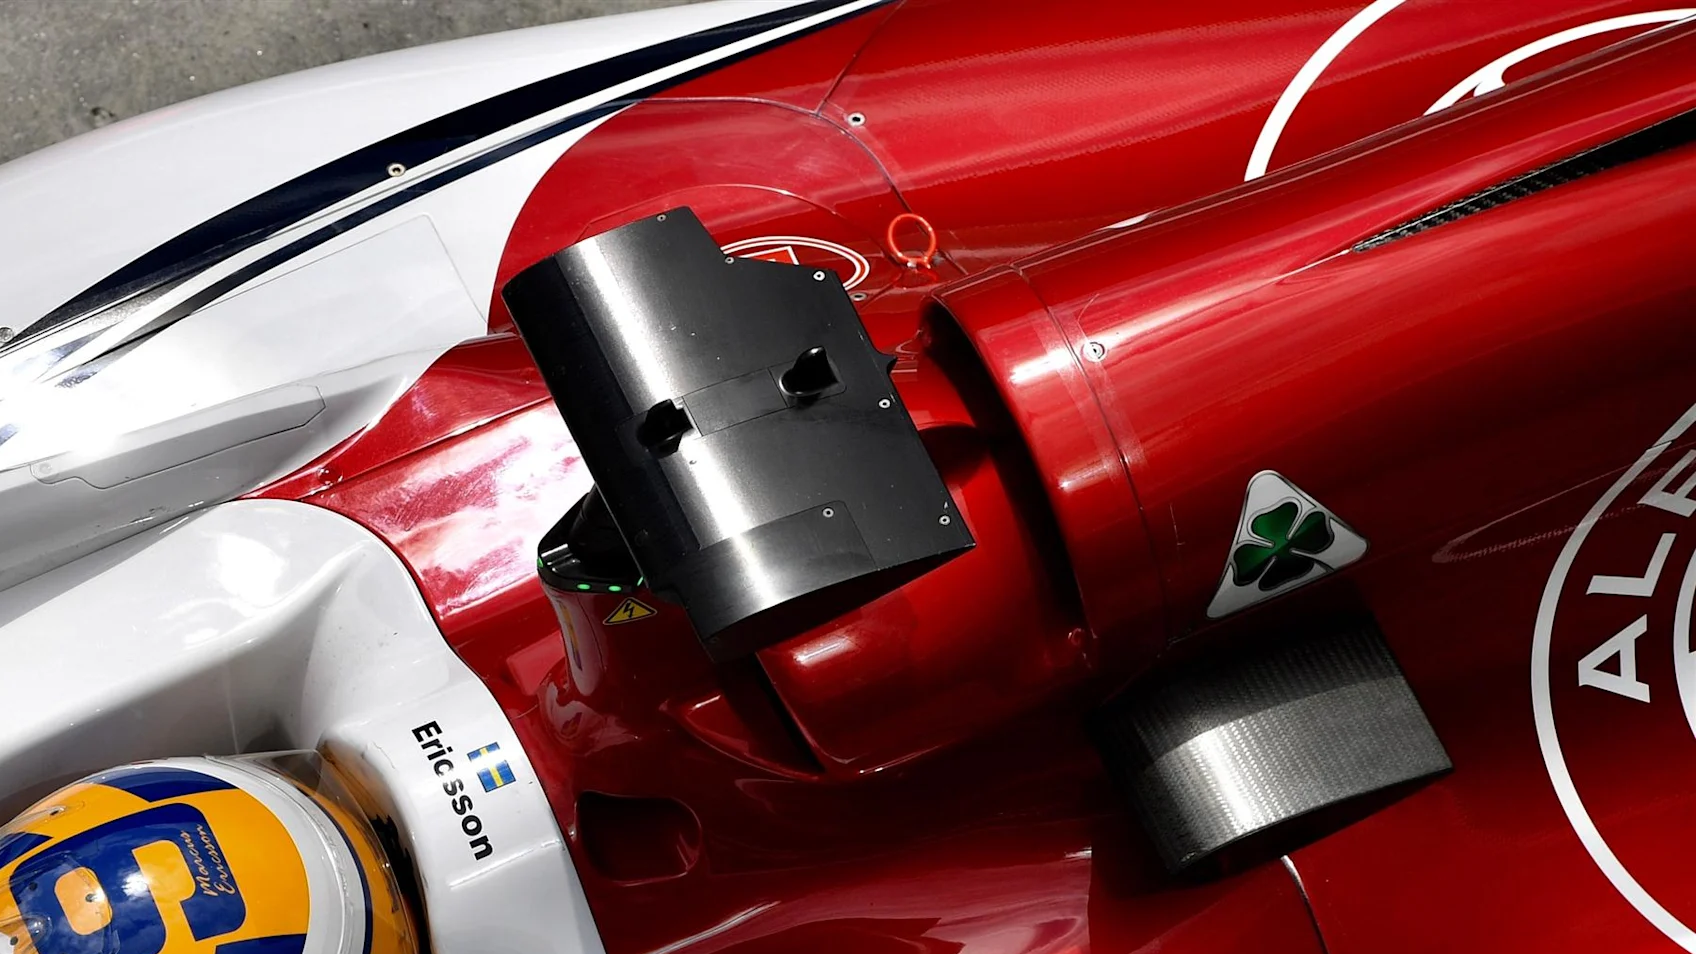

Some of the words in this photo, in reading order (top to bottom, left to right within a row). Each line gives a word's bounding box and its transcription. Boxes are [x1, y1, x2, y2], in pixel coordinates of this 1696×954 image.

[1578, 449, 1696, 703] ALF
[411, 720, 494, 861] Ericsson
[180, 830, 219, 897] Marcus
[197, 824, 236, 894] Ericsson
